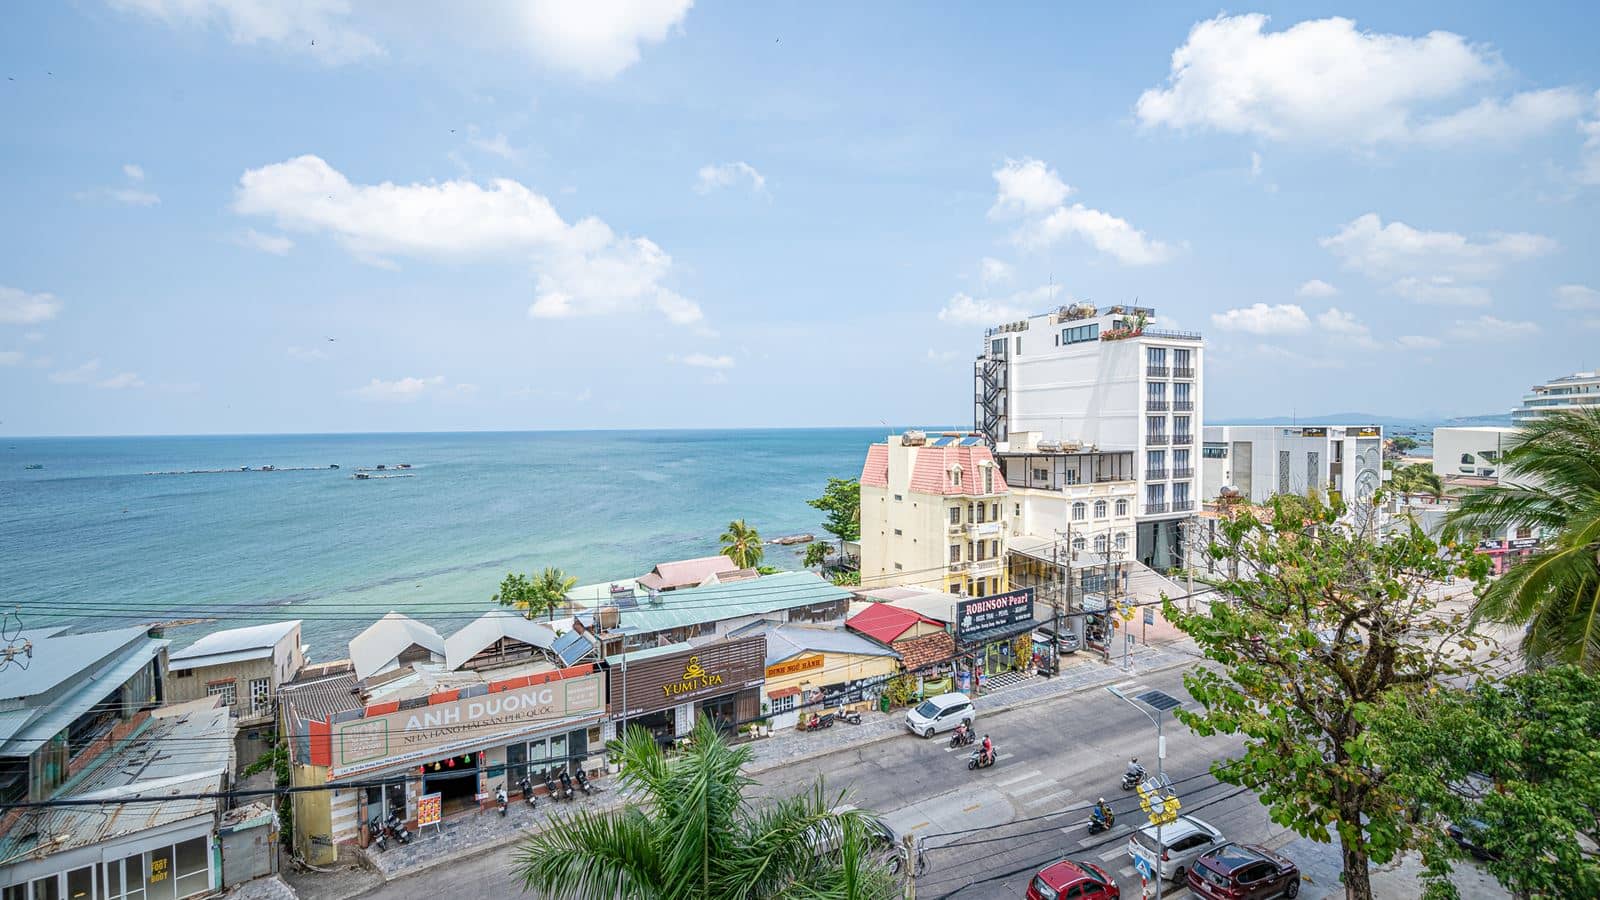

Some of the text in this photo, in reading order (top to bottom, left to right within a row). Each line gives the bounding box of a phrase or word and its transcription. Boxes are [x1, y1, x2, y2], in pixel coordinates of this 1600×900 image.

[966, 597, 1008, 615] ROBINSON
[1009, 593, 1028, 606] Pearl
[663, 680, 698, 697] YUMI
[701, 674, 723, 687] SPA
[404, 707, 460, 731] ANH
[151, 859, 168, 871] FOOT
